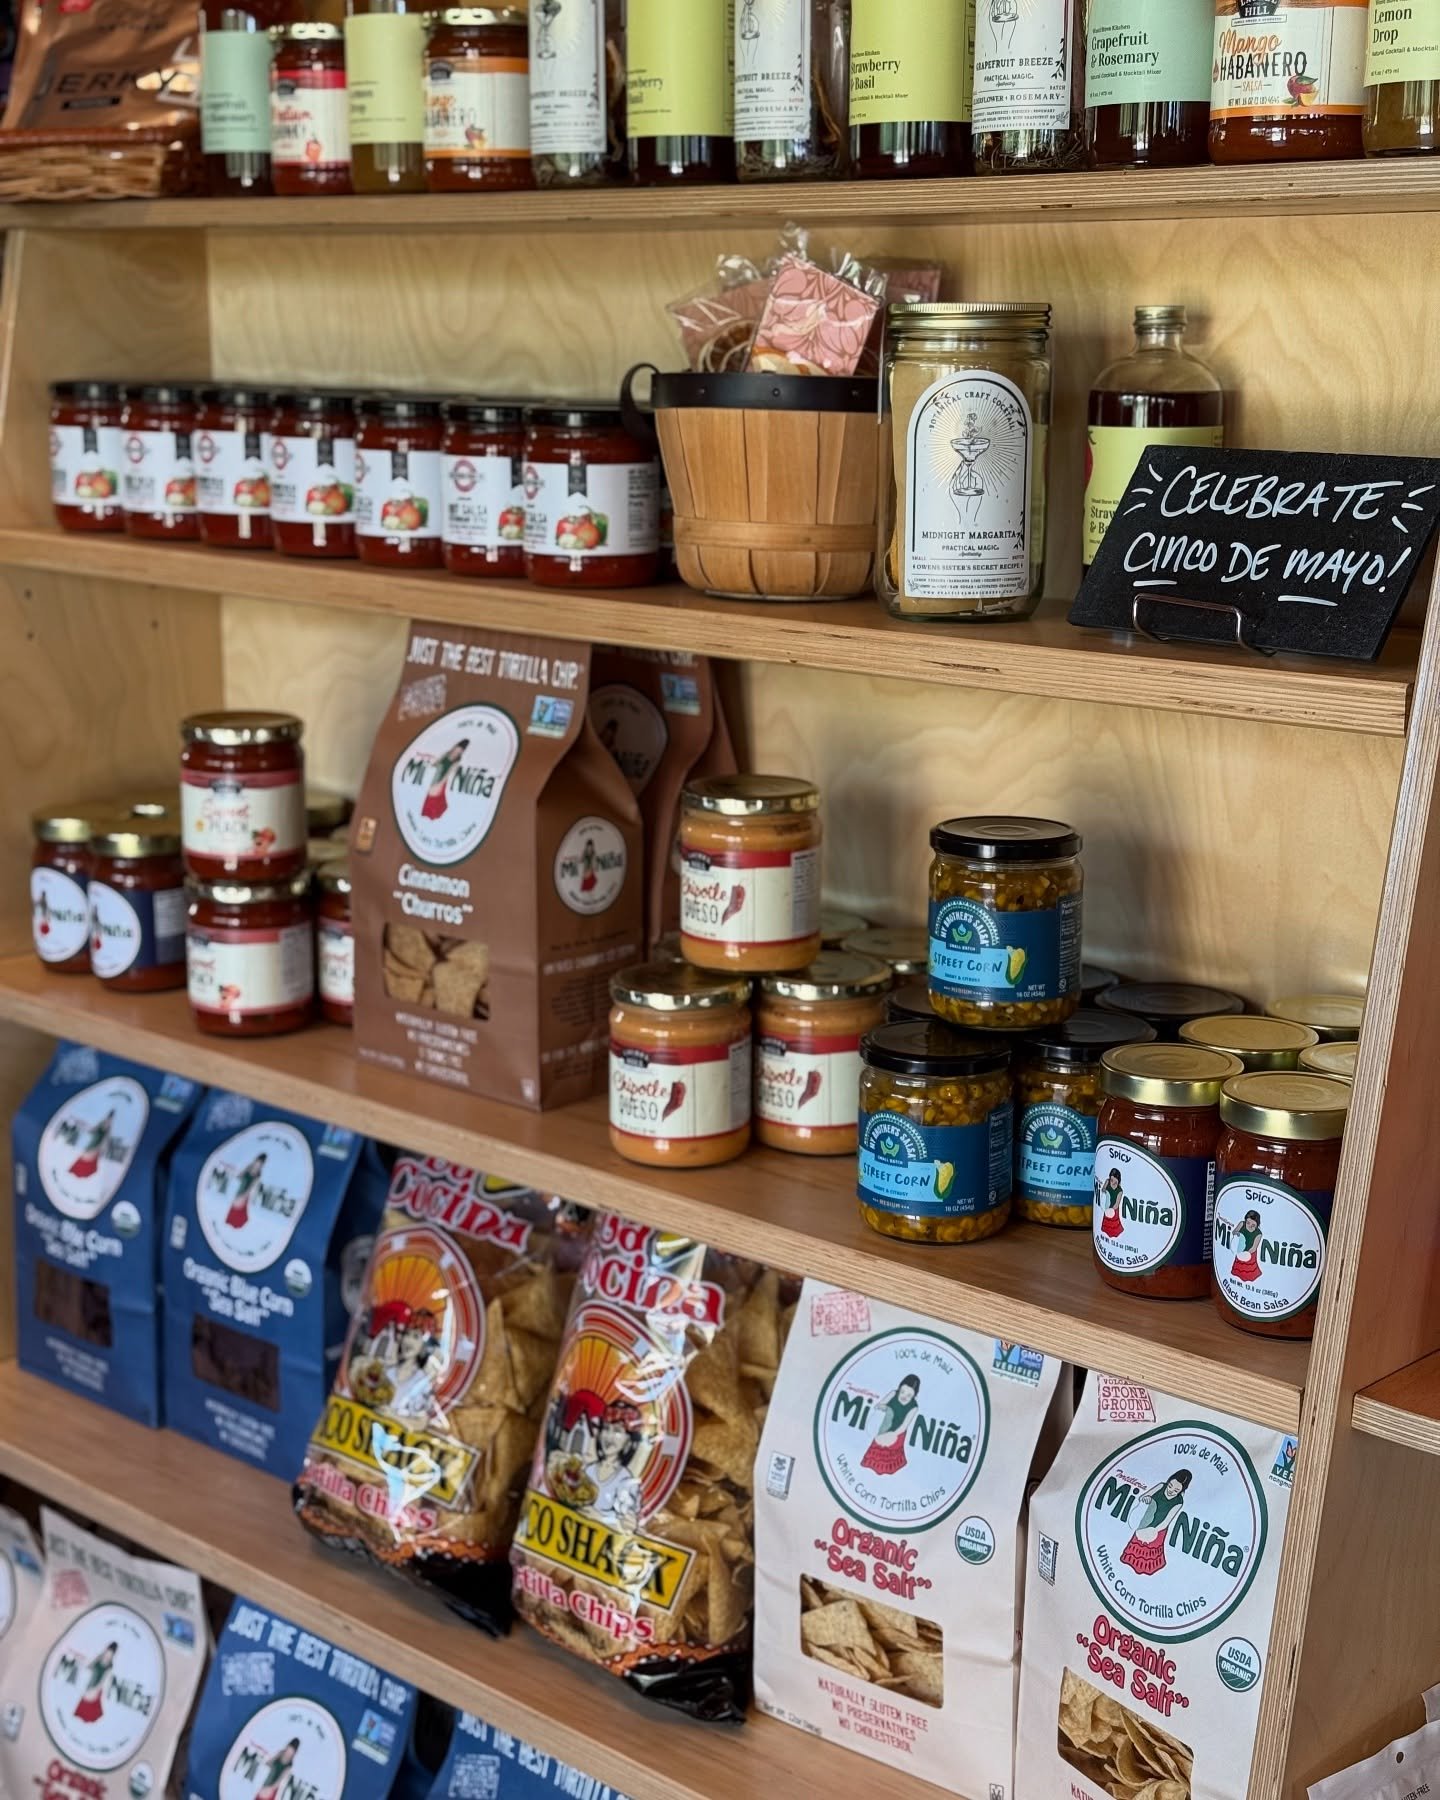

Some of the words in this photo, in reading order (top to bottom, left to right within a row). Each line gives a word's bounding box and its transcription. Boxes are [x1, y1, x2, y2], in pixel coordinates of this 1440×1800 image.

[1245, 6, 1270, 16] HILL
[1374, 8, 1412, 24] Lemon
[1091, 31, 1149, 52] Grapefruit
[1219, 28, 1282, 65] Mango
[1372, 28, 1398, 45] Drop
[1091, 55, 1097, 68] &
[1098, 51, 1159, 67] Rosemary
[1385, 47, 1405, 55] Cocktail
[851, 59, 900, 74] Strawberry
[976, 59, 1015, 71] GRAPEFRUIT
[1018, 57, 1054, 66] BREEZE
[1220, 51, 1307, 81] HABANERO
[761, 72, 791, 80] BREEZE
[855, 76, 875, 90] Basil
[1242, 82, 1263, 92] SALSA
[1010, 93, 1060, 101] ROSEMARY
[964, 391, 990, 400] CRAFT
[992, 397, 1015, 430] COCKTAIL
[1161, 466, 1403, 523] CELEBRATE
[922, 531, 965, 540] MIDNIGHT
[969, 530, 1016, 540] MARGARITA
[1124, 532, 1218, 573] CINCO
[1221, 543, 1281, 582] DE
[1283, 547, 1411, 594] MAYO!
[408, 636, 439, 665] JUST
[440, 641, 467, 671] THE
[465, 646, 496, 676] BEST
[402, 758, 430, 786] Mi
[450, 766, 496, 799] Niña
[398, 863, 470, 898] Cinnamon
[944, 911, 974, 927] BROTHER'S
[972, 919, 989, 945] SALSA
[934, 952, 963, 968] STREET
[967, 959, 1003, 973] CORN
[872, 1124, 901, 1140] BROTHER'S
[1029, 1116, 1065, 1132] BROTHER'S
[869, 1137, 876, 1150] MY
[900, 1133, 917, 1159] SALSA
[1025, 1130, 1034, 1143] MY
[1063, 1124, 1080, 1149] SALSA
[1109, 1148, 1132, 1163] Spicy
[863, 1162, 891, 1182] STREET
[895, 1173, 931, 1187] CORN
[1056, 1163, 1094, 1177] CORN
[1246, 1189, 1274, 1205] Spicy
[1122, 1196, 1172, 1226] Niña
[1215, 1218, 1232, 1250] Mi
[1260, 1239, 1317, 1269] Niña
[1107, 1252, 1125, 1265] Bean
[1126, 1254, 1149, 1265] Salsa
[1222, 1278, 1239, 1301] Black
[1240, 1296, 1261, 1311] Bean
[1264, 1298, 1289, 1311] Salsa
[894, 1348, 917, 1360] 100%
[920, 1350, 931, 1361] de
[1021, 1350, 1043, 1362] GMO
[995, 1360, 1040, 1379] VERIFIED
[1102, 1386, 1147, 1399] STONE
[1102, 1399, 1152, 1411] GROUND
[1110, 1411, 1145, 1419] CORN
[832, 1390, 873, 1430] Mi
[909, 1414, 972, 1464] Niña
[1173, 1443, 1197, 1456] 100%
[1198, 1447, 1211, 1461] de
[1212, 1452, 1229, 1477] Maiz
[836, 1453, 855, 1486] White
[854, 1483, 877, 1506] Corn
[880, 1496, 917, 1512] Tortilla
[919, 1486, 946, 1509] Chips
[965, 1525, 986, 1541] USDA
[1095, 1476, 1139, 1522] Mi
[1169, 1511, 1243, 1578] Niña
[831, 1517, 919, 1571] Organic
[958, 1538, 990, 1555] ORGANIC
[814, 1538, 867, 1583] “Sea
[872, 1562, 932, 1600] Salt”
[1096, 1544, 1116, 1582] White
[1114, 1579, 1136, 1606] Corn
[1137, 1598, 1174, 1618] Tortilla
[1176, 1596, 1207, 1617] Chips
[571, 1592, 653, 1640] Chips
[228, 1605, 269, 1642] JUST
[267, 1618, 297, 1656] THE
[294, 1631, 331, 1671] BEST
[1093, 1614, 1177, 1685] Organic
[1227, 1646, 1252, 1668] USDA
[1076, 1633, 1126, 1689] “Sea
[1131, 1668, 1190, 1717] Salt”
[1221, 1660, 1252, 1683] ORGANIC
[818, 1677, 866, 1706] NATURALLY
[869, 1697, 902, 1721] GLUTEN
[905, 1713, 929, 1732] FREE
[832, 1698, 843, 1713] NO
[847, 1705, 916, 1741] PRESERVATIVES
[839, 1717, 850, 1730] NO
[854, 1723, 912, 1753] CHOLESTEROL
[493, 1727, 516, 1760] THE
[518, 1740, 550, 1780] BEST
